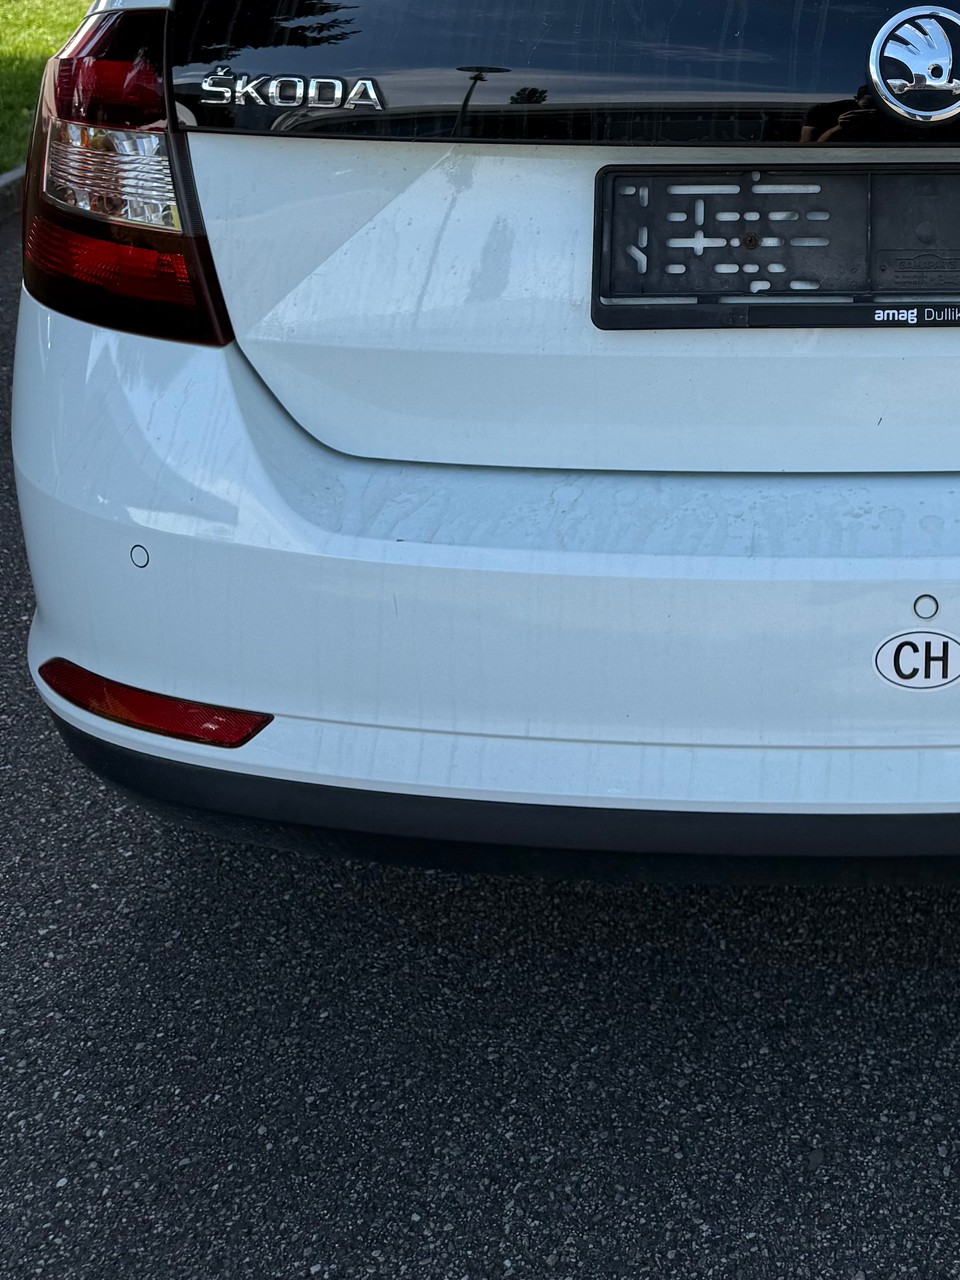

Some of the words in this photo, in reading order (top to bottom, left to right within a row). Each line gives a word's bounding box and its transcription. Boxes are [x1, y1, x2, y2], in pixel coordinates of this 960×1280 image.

[200, 66, 384, 111] ŠKODA
[874, 308, 918, 324] amag
[893, 640, 950, 680] CH
